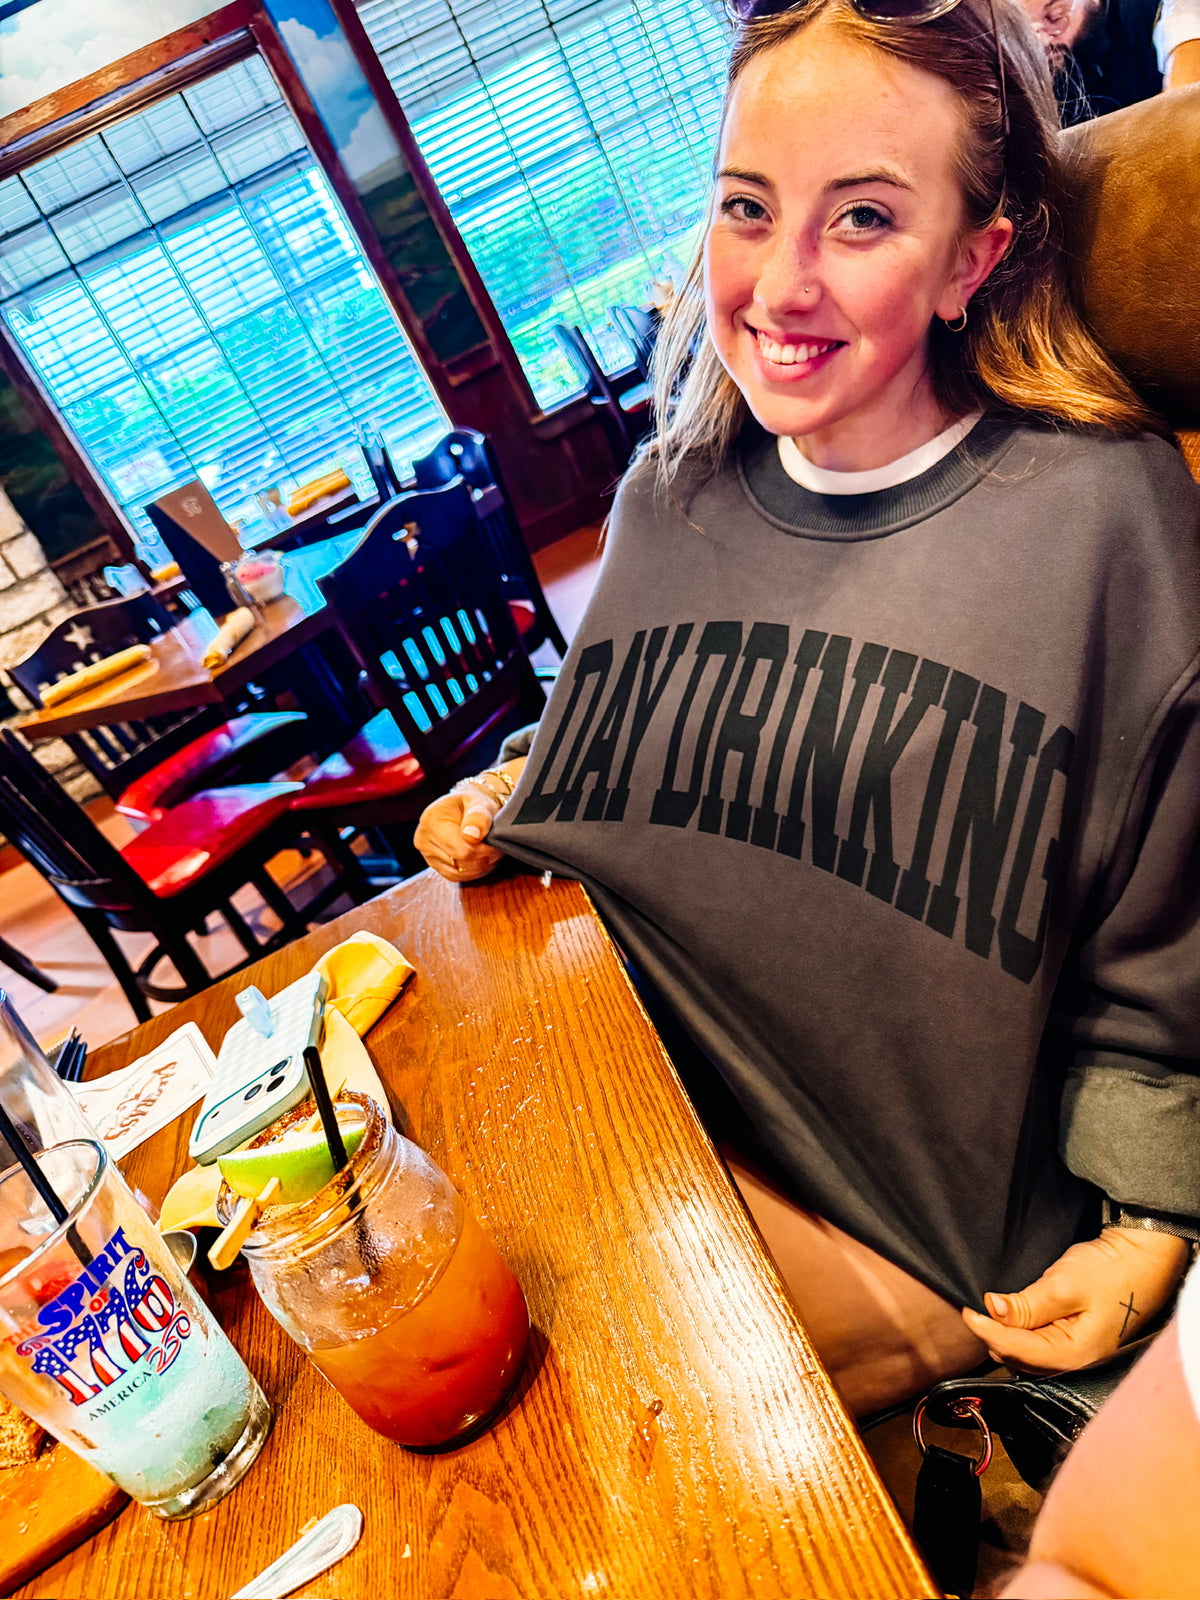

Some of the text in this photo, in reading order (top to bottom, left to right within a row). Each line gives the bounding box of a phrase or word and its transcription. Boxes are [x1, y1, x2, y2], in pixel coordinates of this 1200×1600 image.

[512, 621, 1075, 984] DAY DRINKING
[3, 1226, 146, 1346] THE SPIRIT
[31, 1251, 175, 1407] 1776
[89, 1287, 111, 1314] OF
[89, 1310, 191, 1422] AMERICA 250
